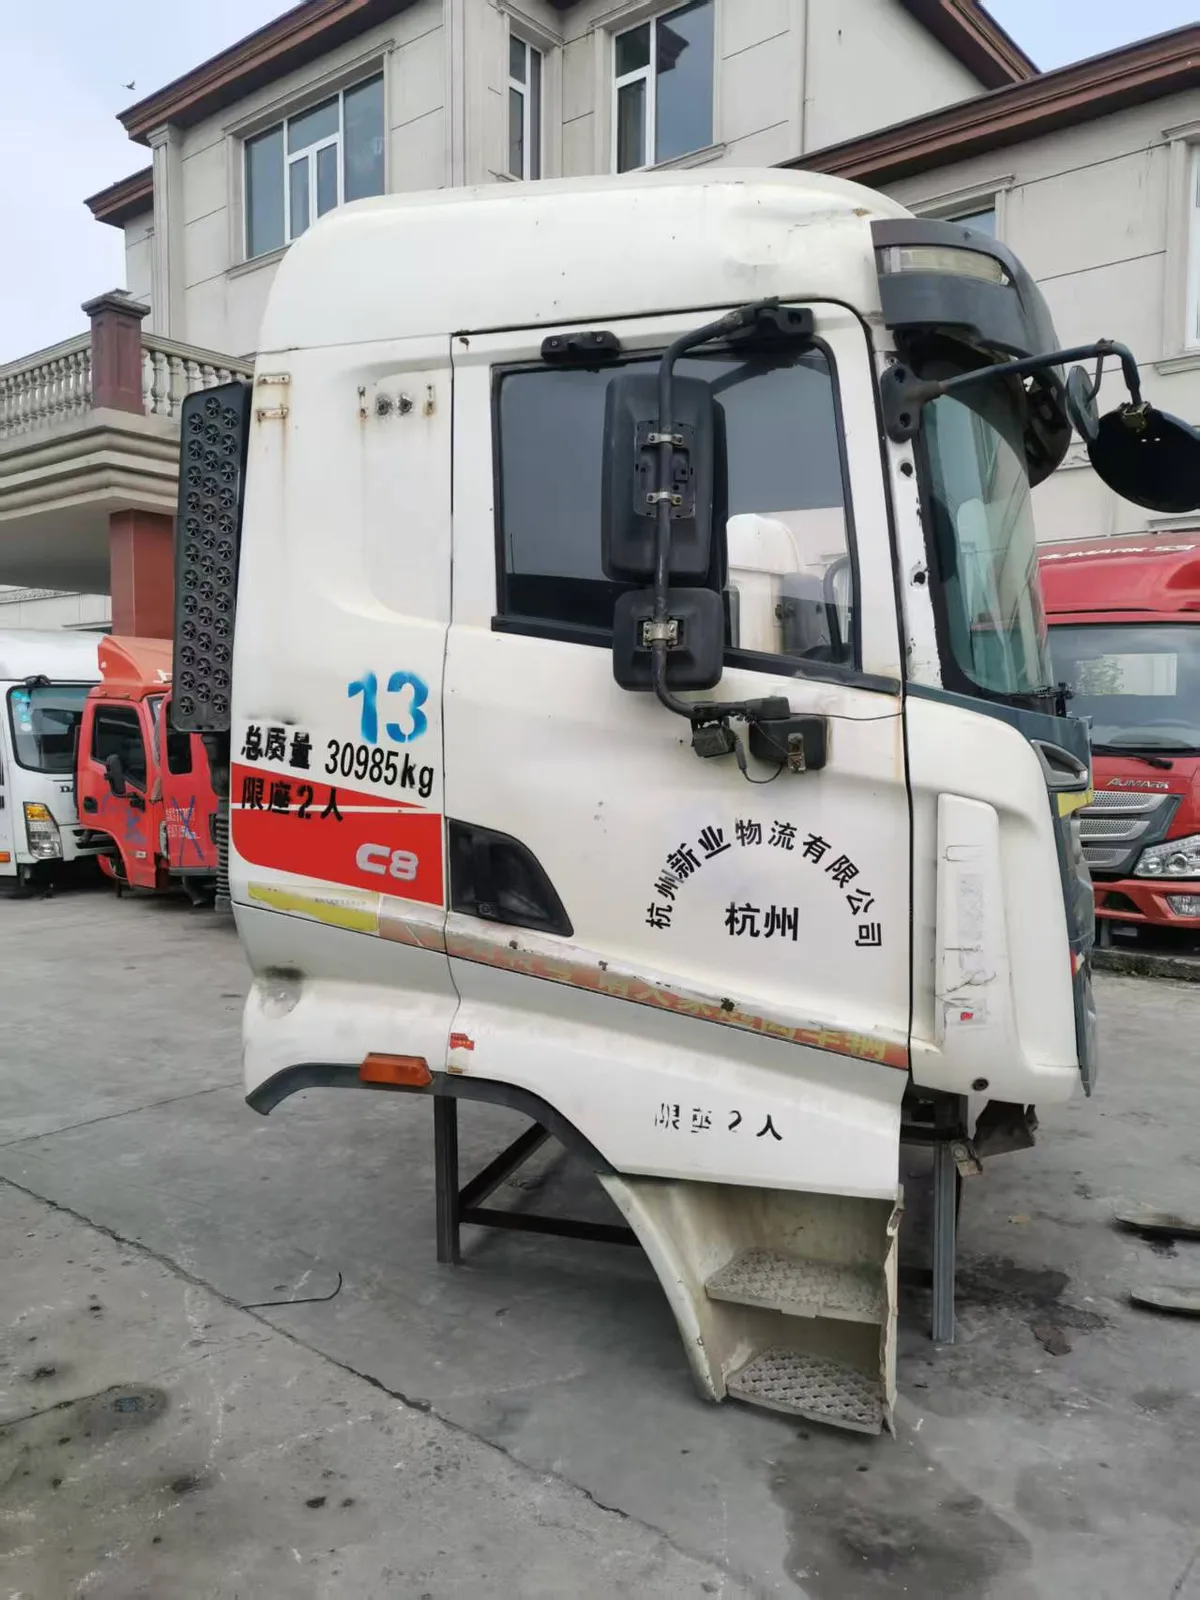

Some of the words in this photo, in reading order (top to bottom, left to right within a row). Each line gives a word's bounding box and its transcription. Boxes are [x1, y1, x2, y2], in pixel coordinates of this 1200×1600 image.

[347, 670, 429, 744] 13
[241, 725, 313, 769] 总质量
[325, 739, 434, 798] 30985kg
[1106, 777, 1169, 789] AUMARK
[355, 843, 418, 881] C8
[645, 819, 882, 948] 杭州新业物流有限公司
[724, 901, 799, 941] 杭州
